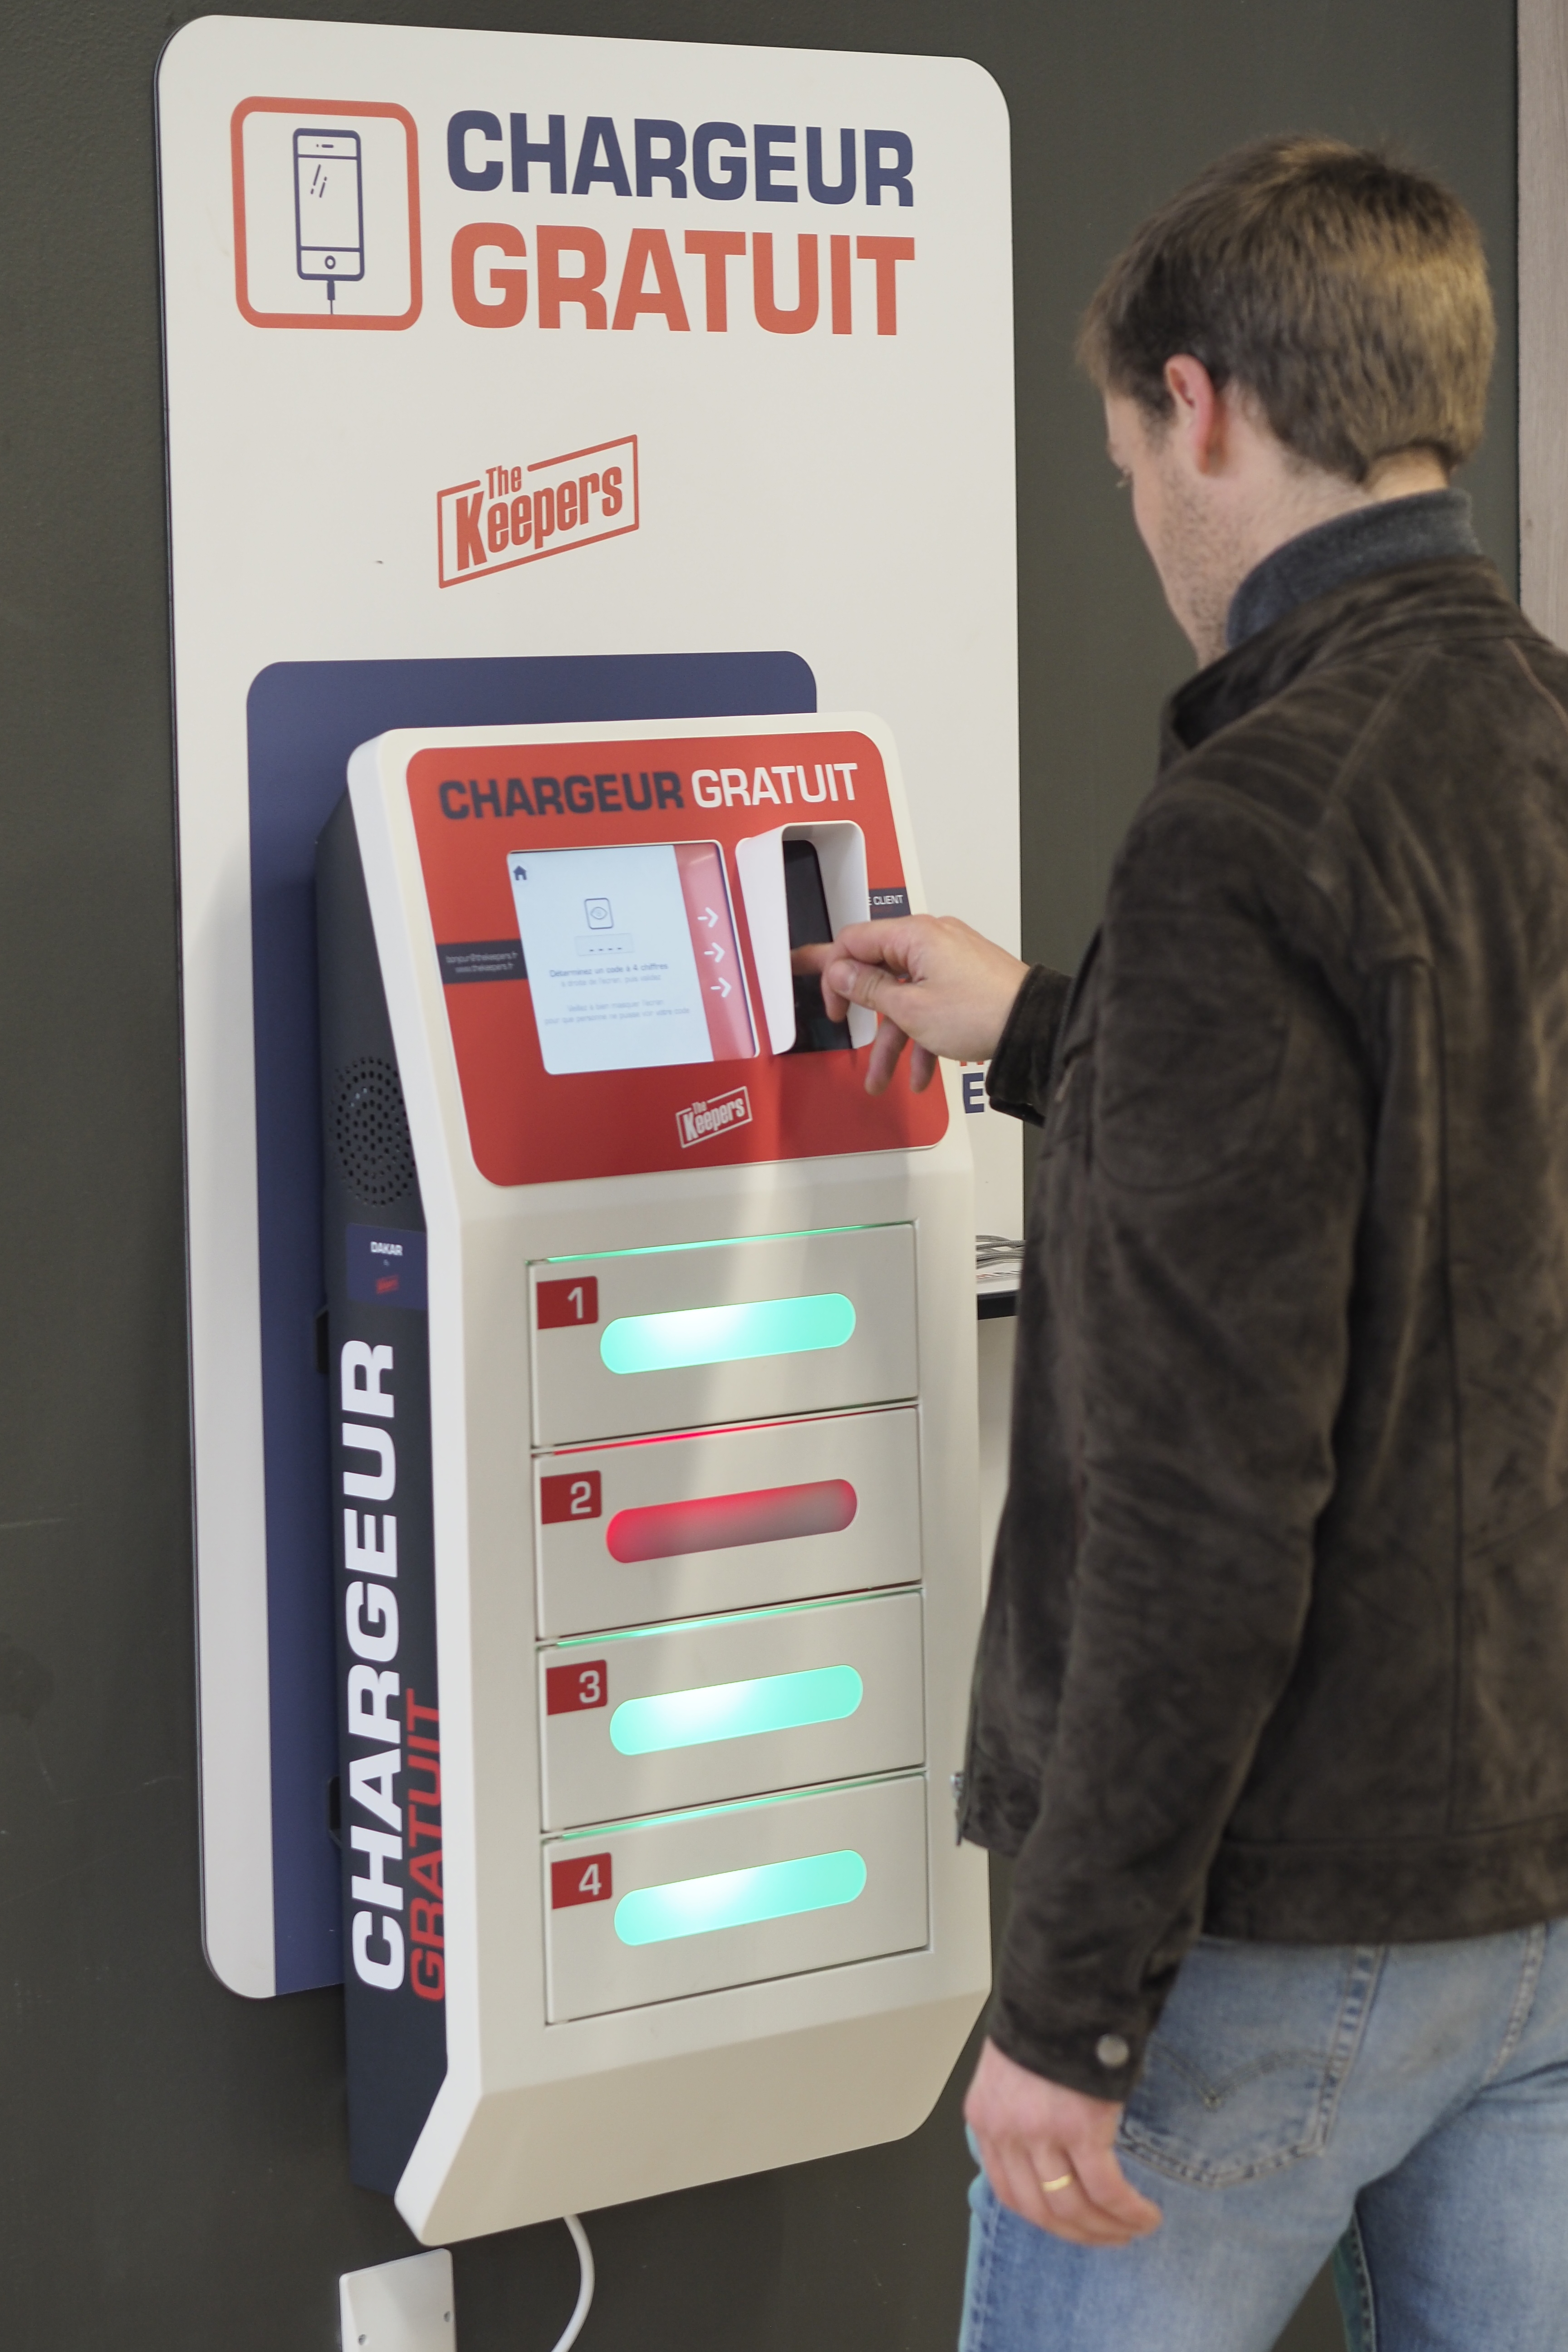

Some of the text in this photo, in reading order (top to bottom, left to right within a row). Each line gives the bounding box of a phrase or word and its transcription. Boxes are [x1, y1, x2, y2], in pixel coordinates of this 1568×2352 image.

[447, 110, 914, 207] CHARGEUR
[451, 222, 915, 336] GRATUIT
[485, 465, 521, 499] The
[456, 466, 622, 571] Keepers
[439, 763, 857, 819] CHARGEUR GRATUIT
[873, 895, 903, 905] CLIENT
[683, 1098, 745, 1141] Keepers
[370, 1241, 403, 1256] DAKAR
[568, 1287, 583, 1319] 1
[570, 1481, 592, 1515] 2
[341, 1340, 405, 1990] CHARGEUR
[578, 1670, 601, 1704] 3
[407, 1688, 445, 2002] GRATUIT
[578, 1863, 602, 1896] 4
